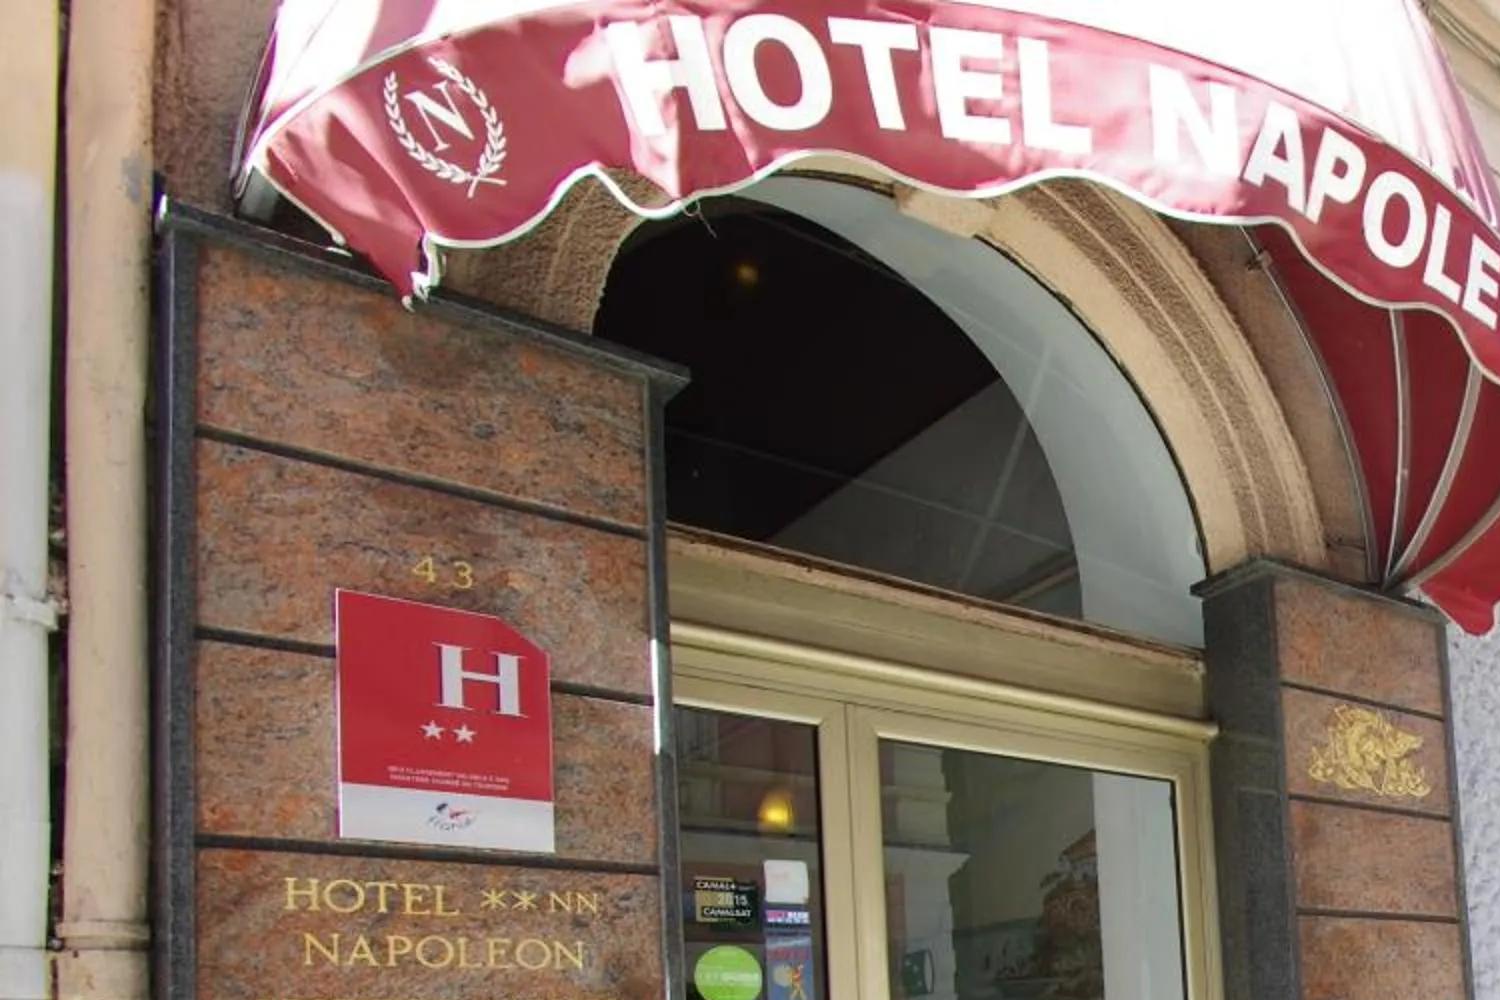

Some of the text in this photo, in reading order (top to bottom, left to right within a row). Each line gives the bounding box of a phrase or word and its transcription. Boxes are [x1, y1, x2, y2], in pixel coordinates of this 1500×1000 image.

[606, 13, 1092, 155] HOTEL
[402, 80, 476, 153] N
[411, 556, 474, 589] 43
[432, 640, 530, 719] H
[283, 877, 461, 917] HOTEL
[302, 932, 585, 970] NAPOLEON
